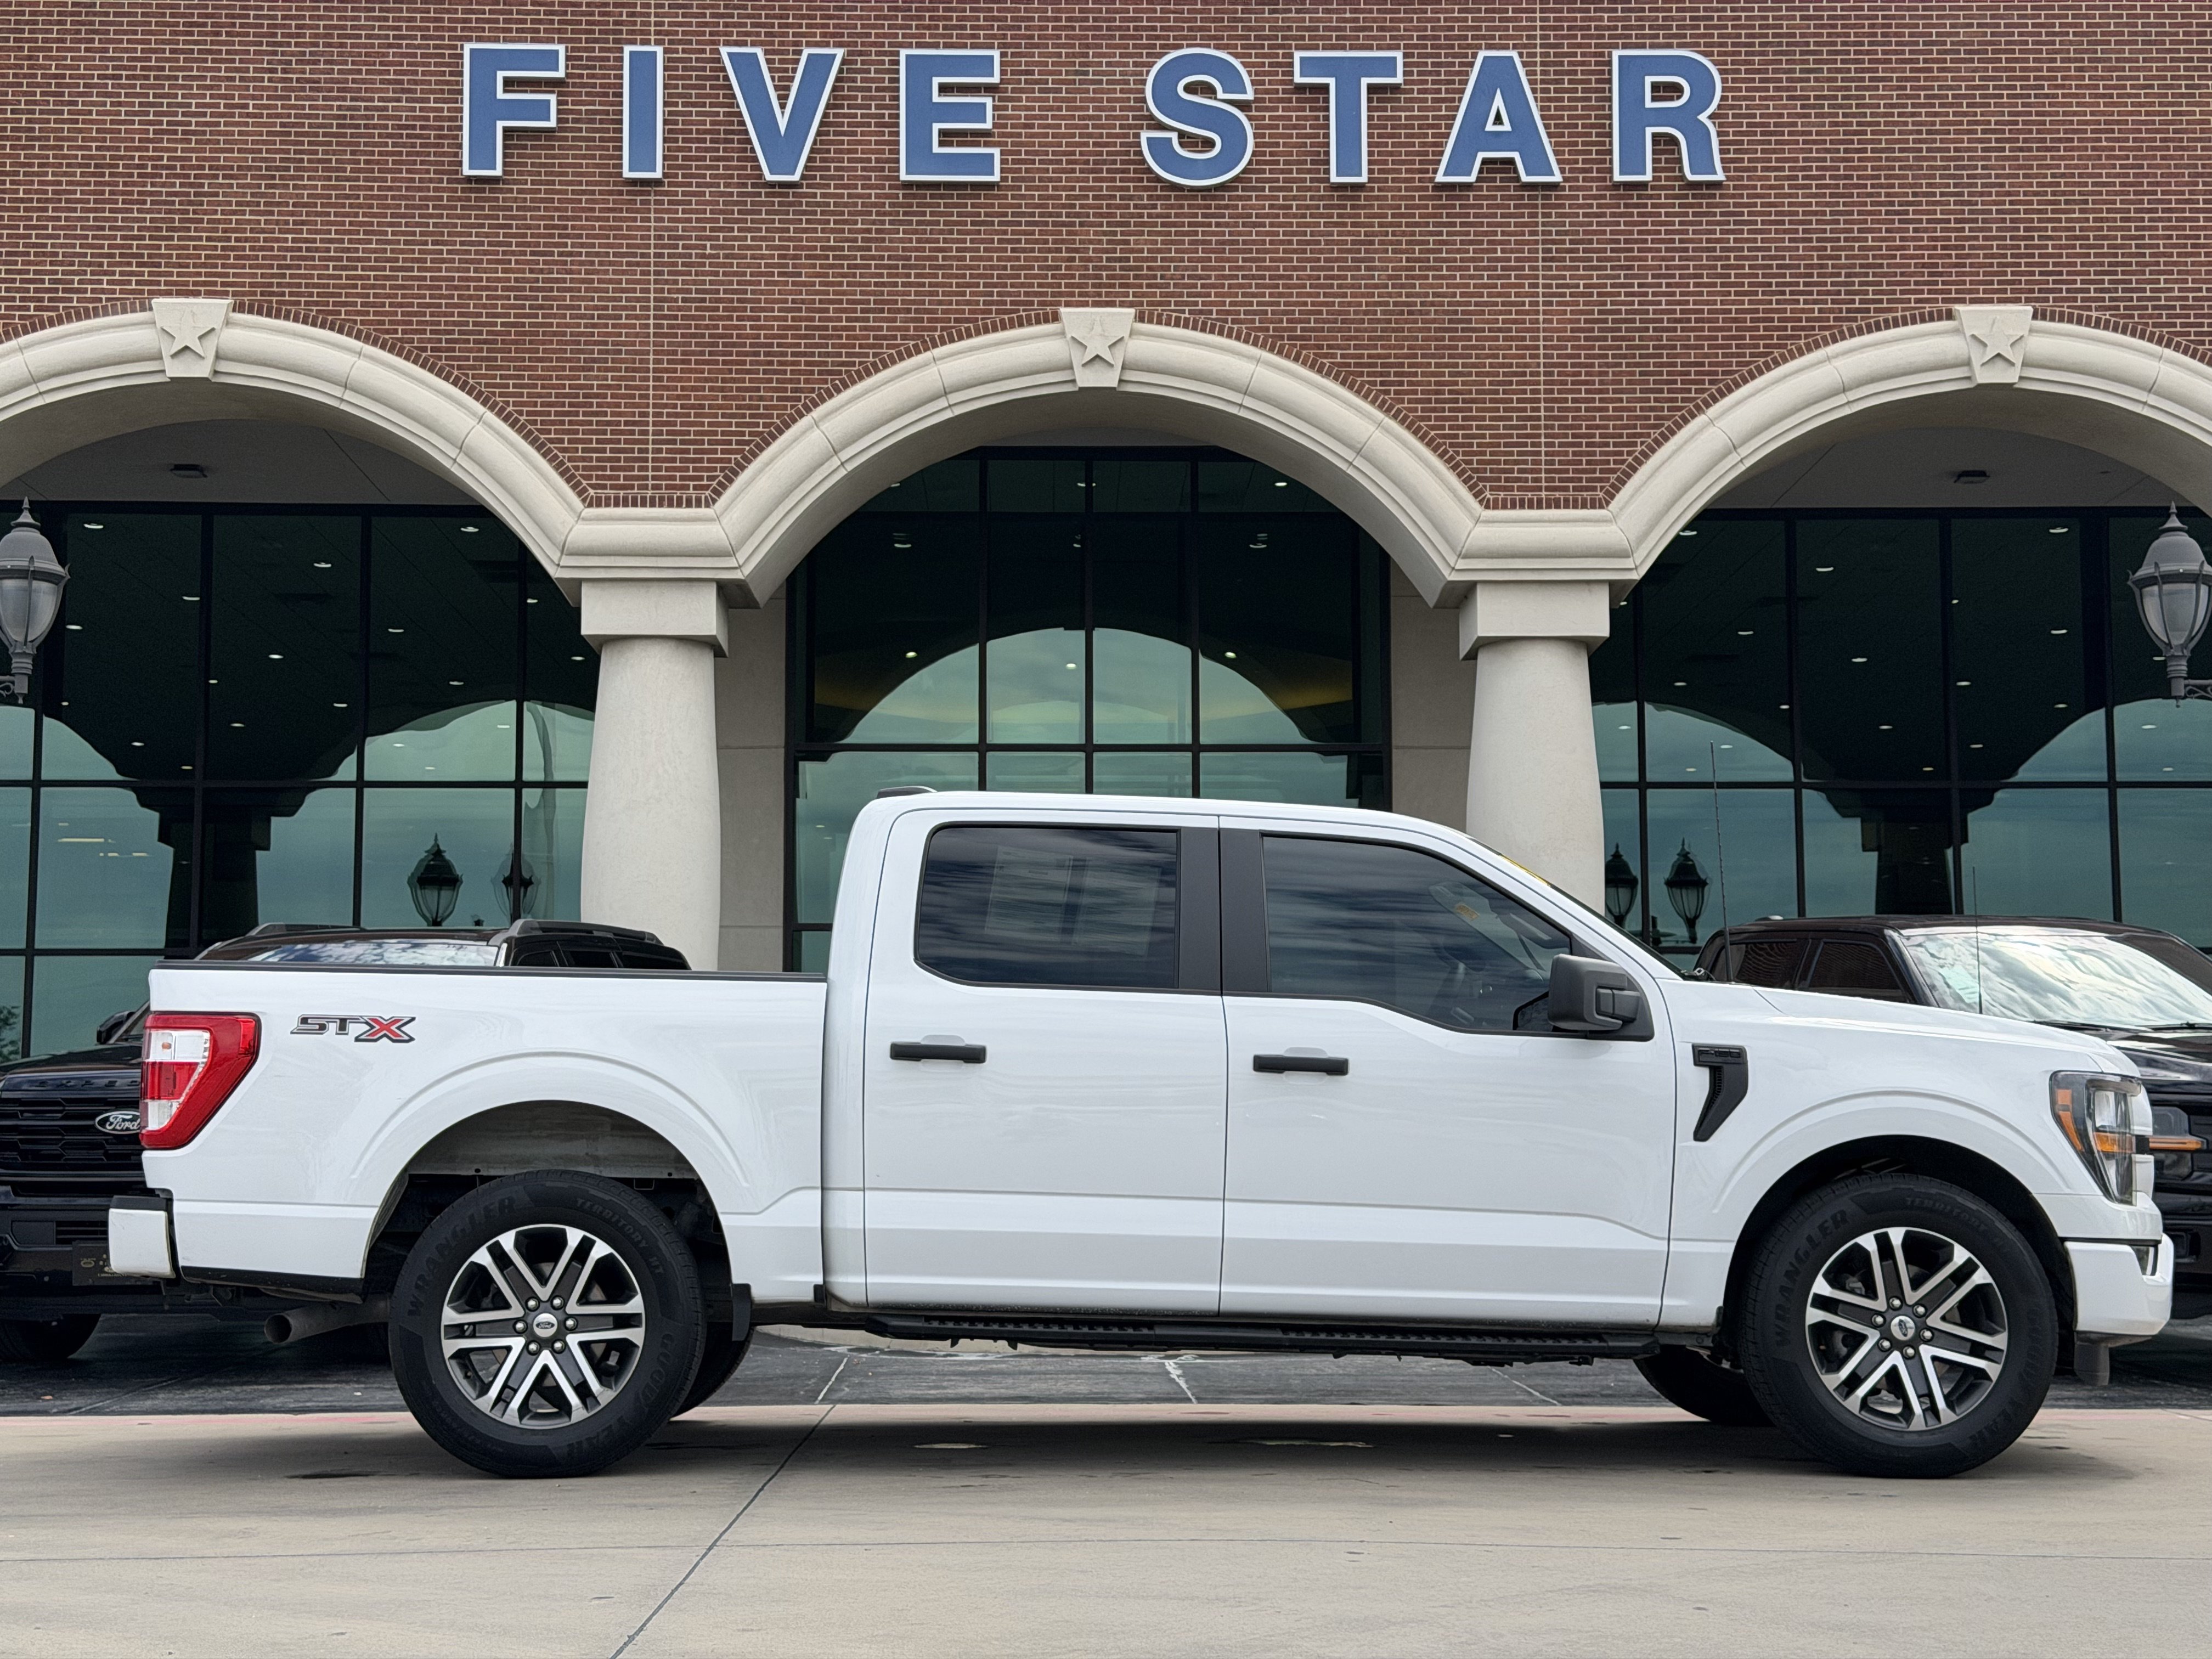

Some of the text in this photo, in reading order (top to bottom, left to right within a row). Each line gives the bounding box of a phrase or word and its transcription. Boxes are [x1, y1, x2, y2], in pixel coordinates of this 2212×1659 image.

[462, 43, 1726, 188] FIVE STAR
[290, 1014, 416, 1043] STX
[106, 1114, 140, 1130] Ford
[1772, 1209, 1850, 1347] WRANGLER
